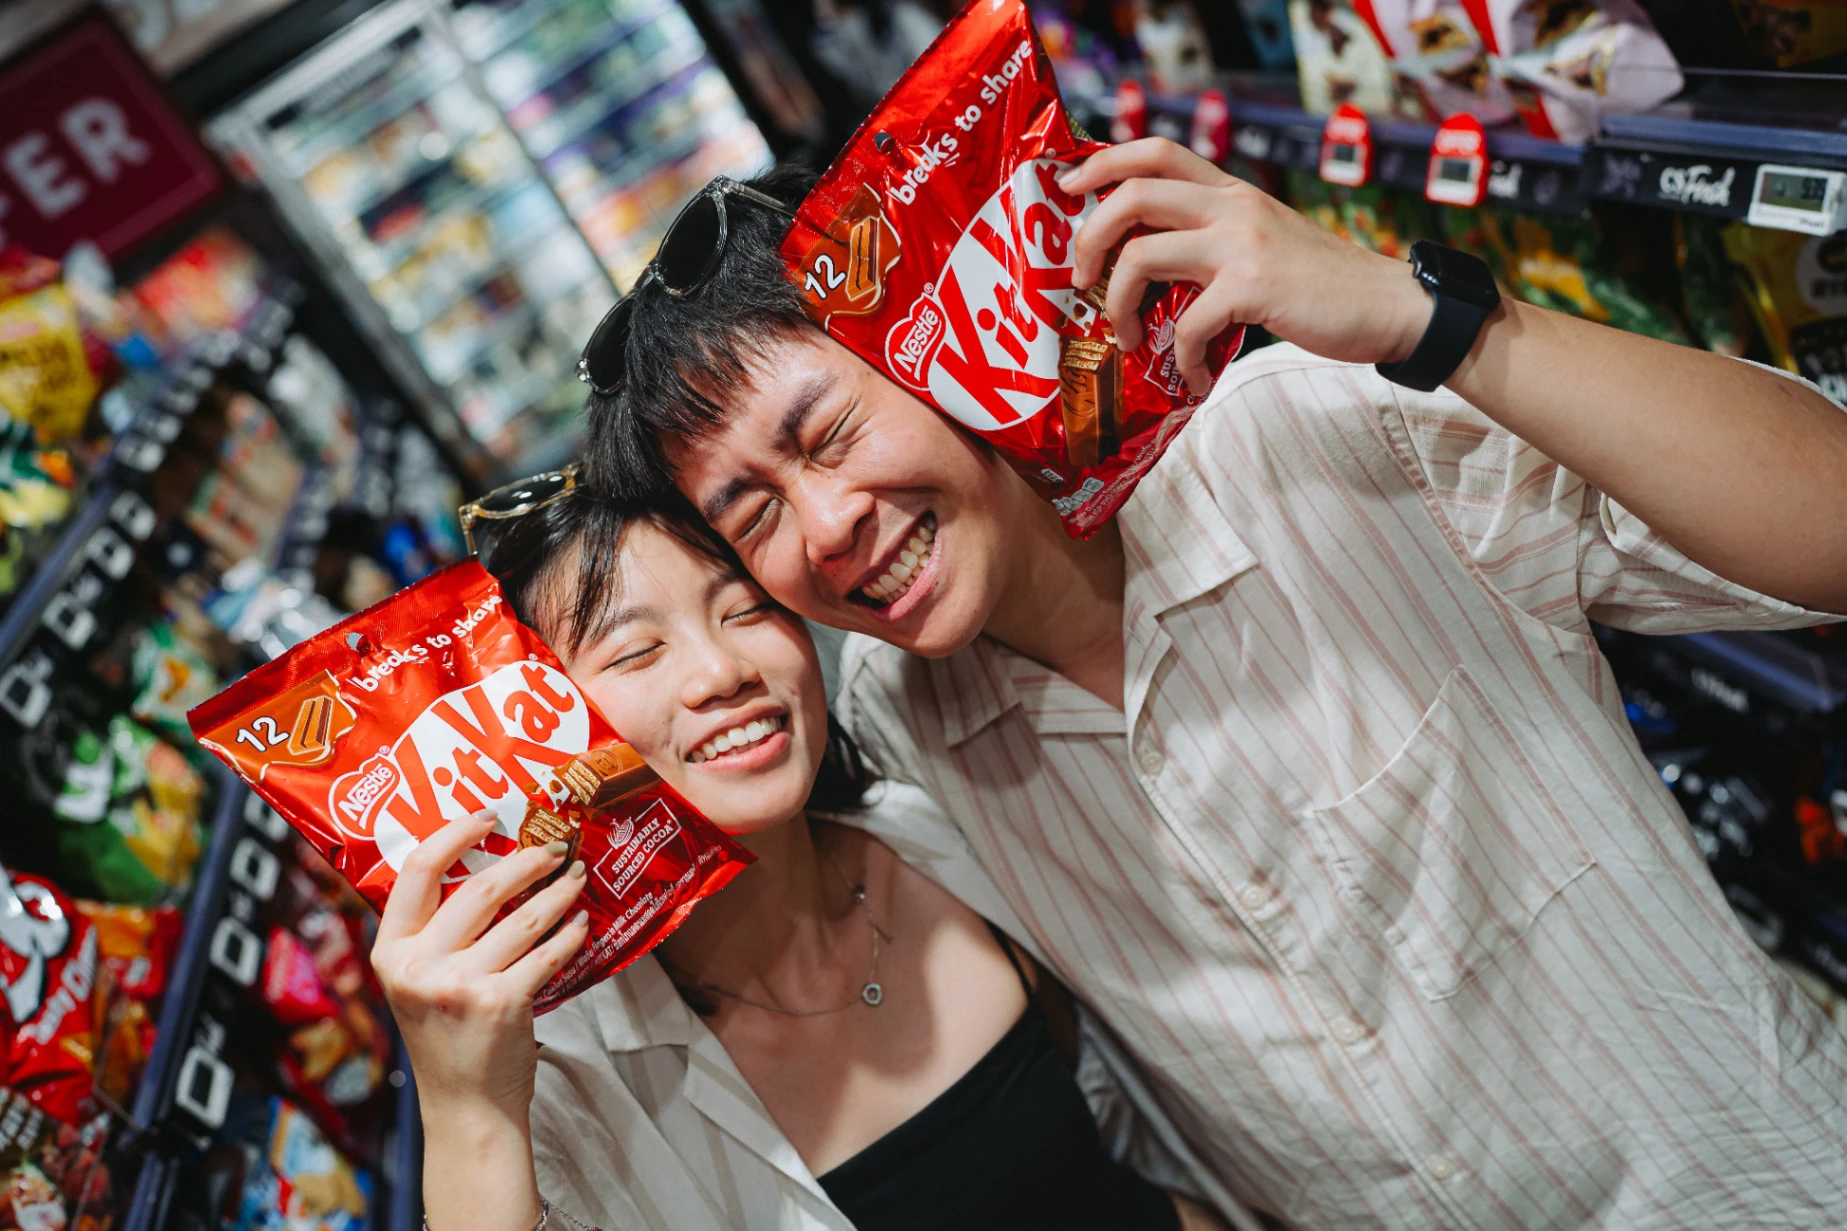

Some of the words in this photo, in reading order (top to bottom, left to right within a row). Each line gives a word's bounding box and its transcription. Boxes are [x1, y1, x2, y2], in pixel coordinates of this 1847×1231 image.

[889, 132, 959, 206] breaks
[954, 104, 982, 133] to
[980, 39, 1033, 106] share
[0, 97, 153, 242] ER
[804, 253, 847, 300] 12
[893, 304, 940, 374] Nestlé
[358, 641, 429, 692] breaks
[427, 631, 452, 651] to
[451, 592, 503, 639] share
[235, 715, 290, 753] 12
[338, 762, 393, 822] Nestlé
[611, 817, 660, 875] SUSTAINABLY
[613, 851, 646, 892] SOURCED
[561, 965, 577, 983] Susu
[592, 932, 613, 955] Fingers
[612, 914, 628, 932] Milk
[624, 891, 654, 920] Chocolate
